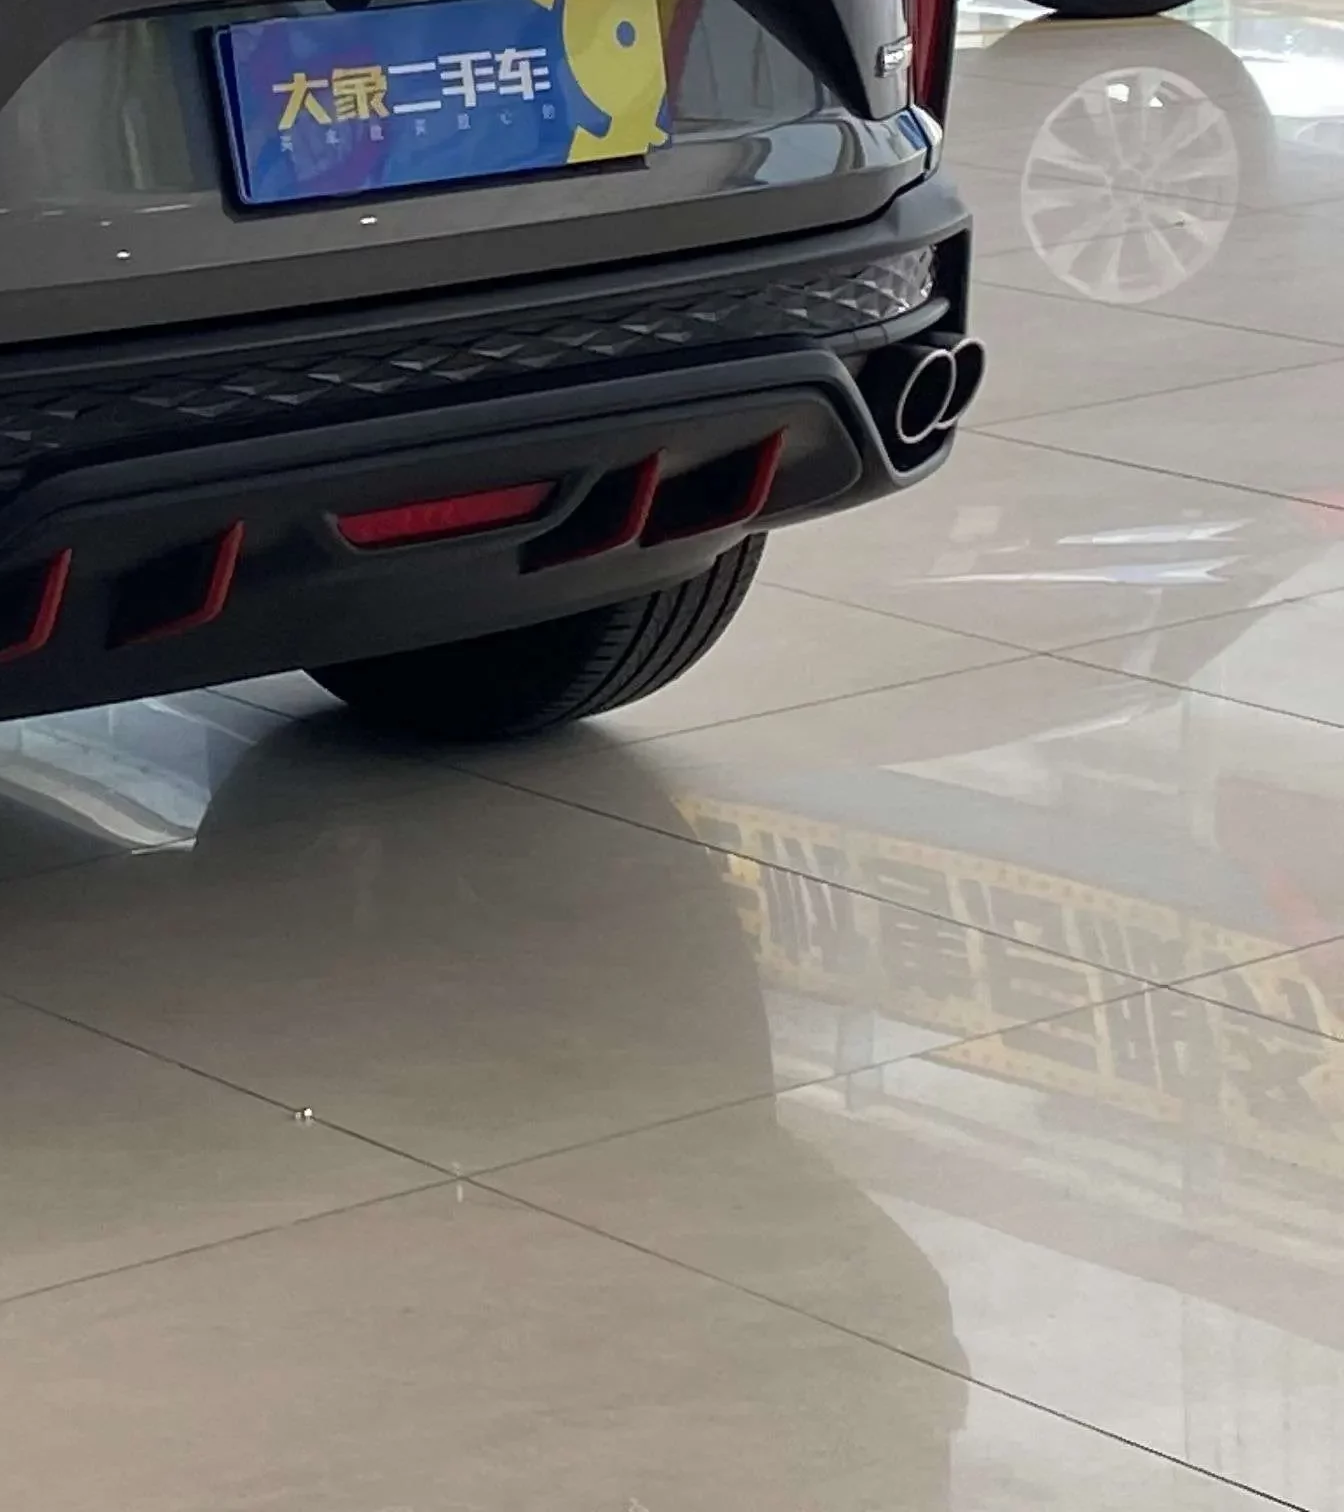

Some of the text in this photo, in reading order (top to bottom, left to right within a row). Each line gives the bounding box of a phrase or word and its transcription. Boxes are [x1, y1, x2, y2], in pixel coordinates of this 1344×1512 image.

[272, 48, 551, 131] 大象二手车
